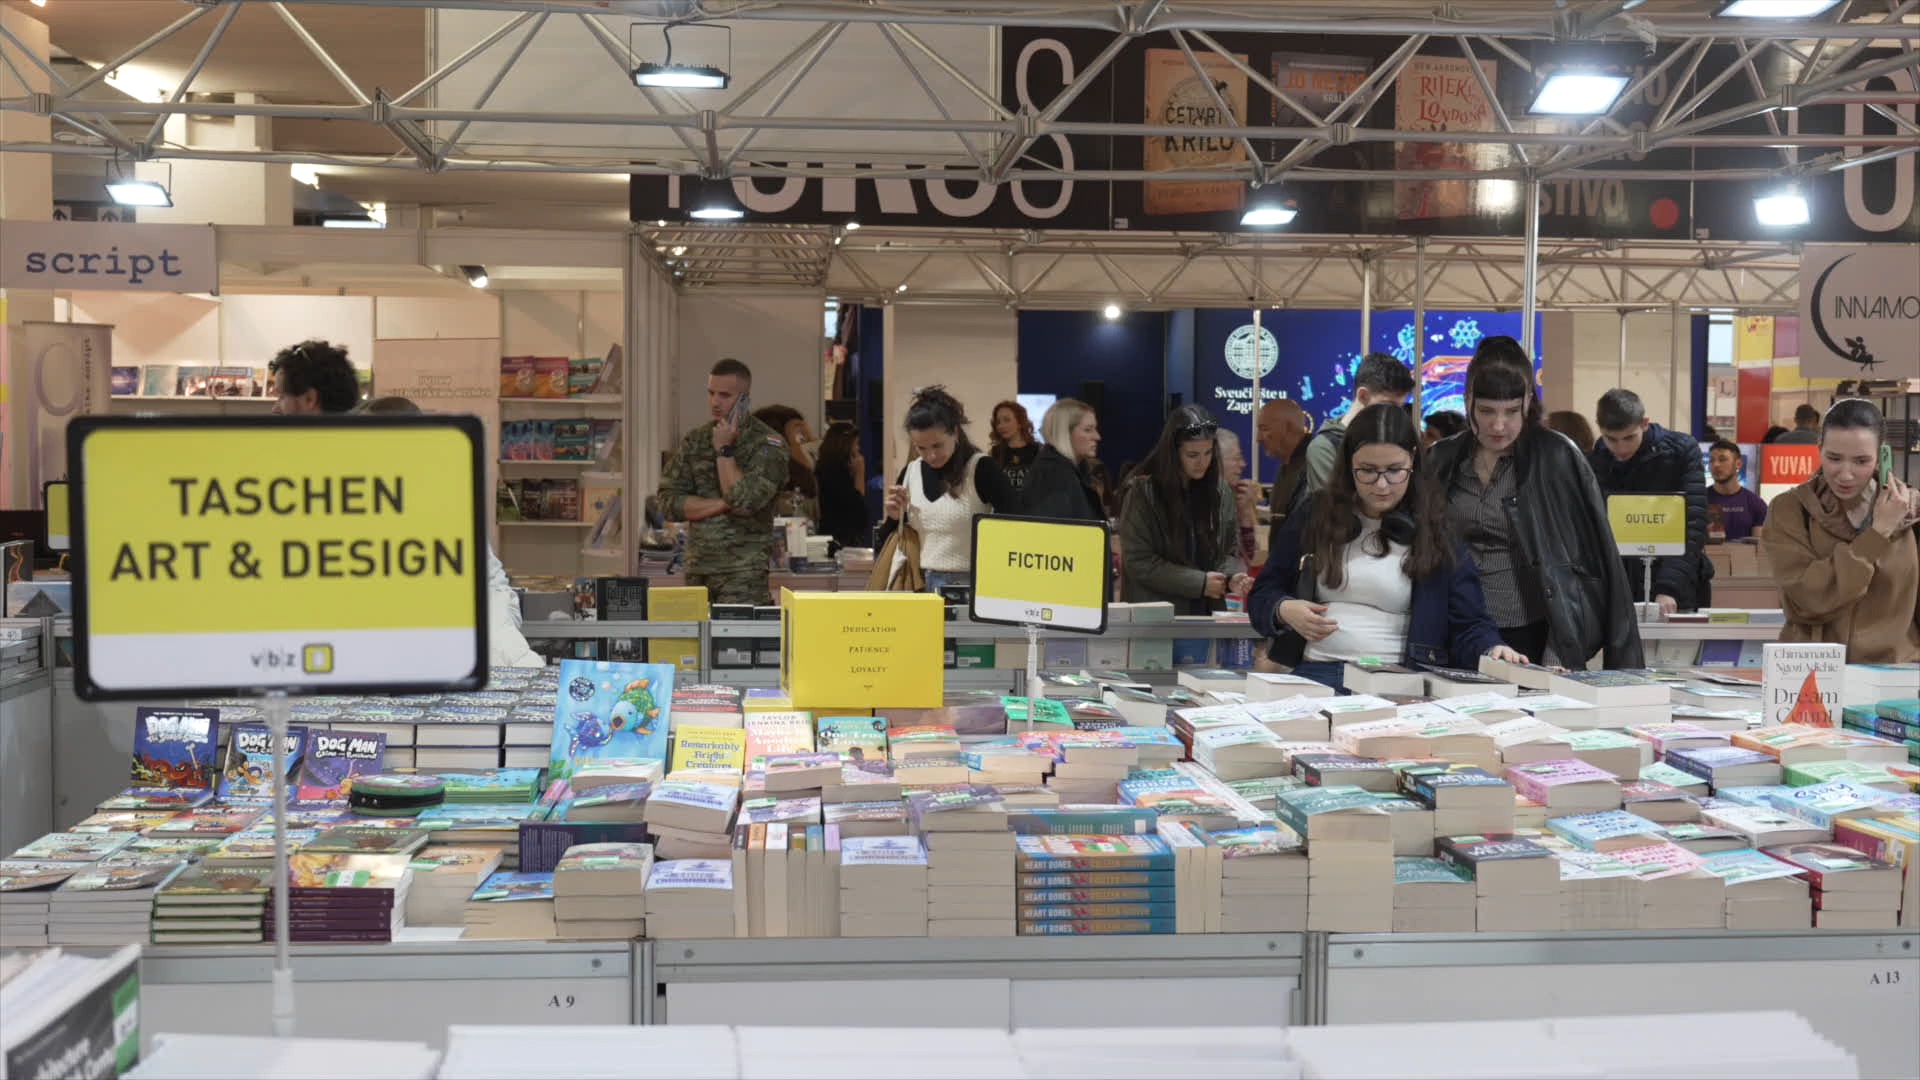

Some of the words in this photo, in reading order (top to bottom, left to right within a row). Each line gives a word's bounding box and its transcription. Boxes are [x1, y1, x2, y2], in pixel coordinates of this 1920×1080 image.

[26, 246, 182, 284] script
[1835, 295, 1920, 319] INNAMO
[1215, 386, 1276, 399] Sveučište
[1279, 389, 1287, 399] u
[1227, 399, 1266, 414] Zagr
[169, 476, 404, 516] TASCHEN
[1625, 513, 1665, 524] OUTLET
[110, 541, 212, 581] ART
[229, 541, 262, 580] &
[281, 538, 464, 579] DESIGN
[1008, 552, 1074, 572] FICTION
[842, 625, 897, 633] DEDICATION
[849, 646, 889, 654] PATIENCE
[1774, 648, 1841, 659] Chimamanda
[850, 666, 888, 674] LOYALTY
[1774, 687, 1838, 705] Dream
[238, 732, 266, 749] DOG
[317, 736, 346, 751] DOG
[348, 738, 378, 753] MAN
[681, 740, 739, 752] Remarkably
[1870, 973, 1880, 984] A
[1886, 970, 1900, 984] 13
[548, 995, 560, 1007] A
[566, 995, 575, 1008] 9
